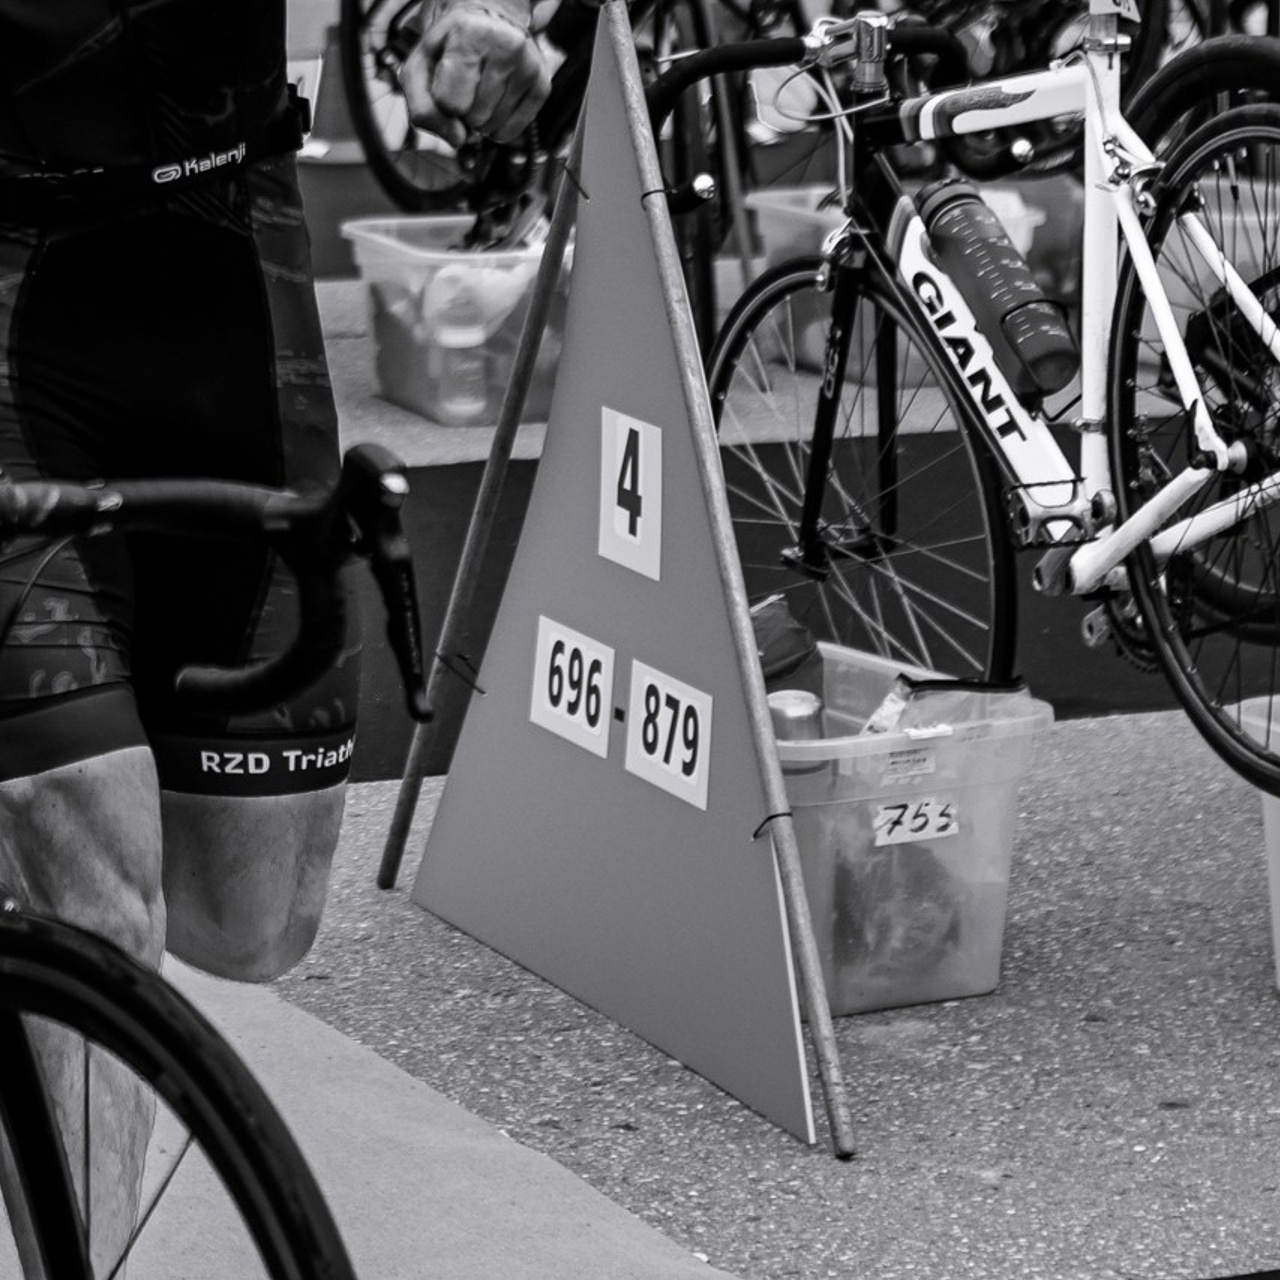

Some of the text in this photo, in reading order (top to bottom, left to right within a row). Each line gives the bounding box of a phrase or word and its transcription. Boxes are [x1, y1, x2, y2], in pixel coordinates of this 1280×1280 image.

[184, 142, 246, 177] Kalenji
[911, 271, 1028, 442] GIANT
[616, 427, 643, 538] 4
[200, 750, 271, 774] RZD
[548, 639, 603, 728] 696
[641, 683, 700, 778] 879
